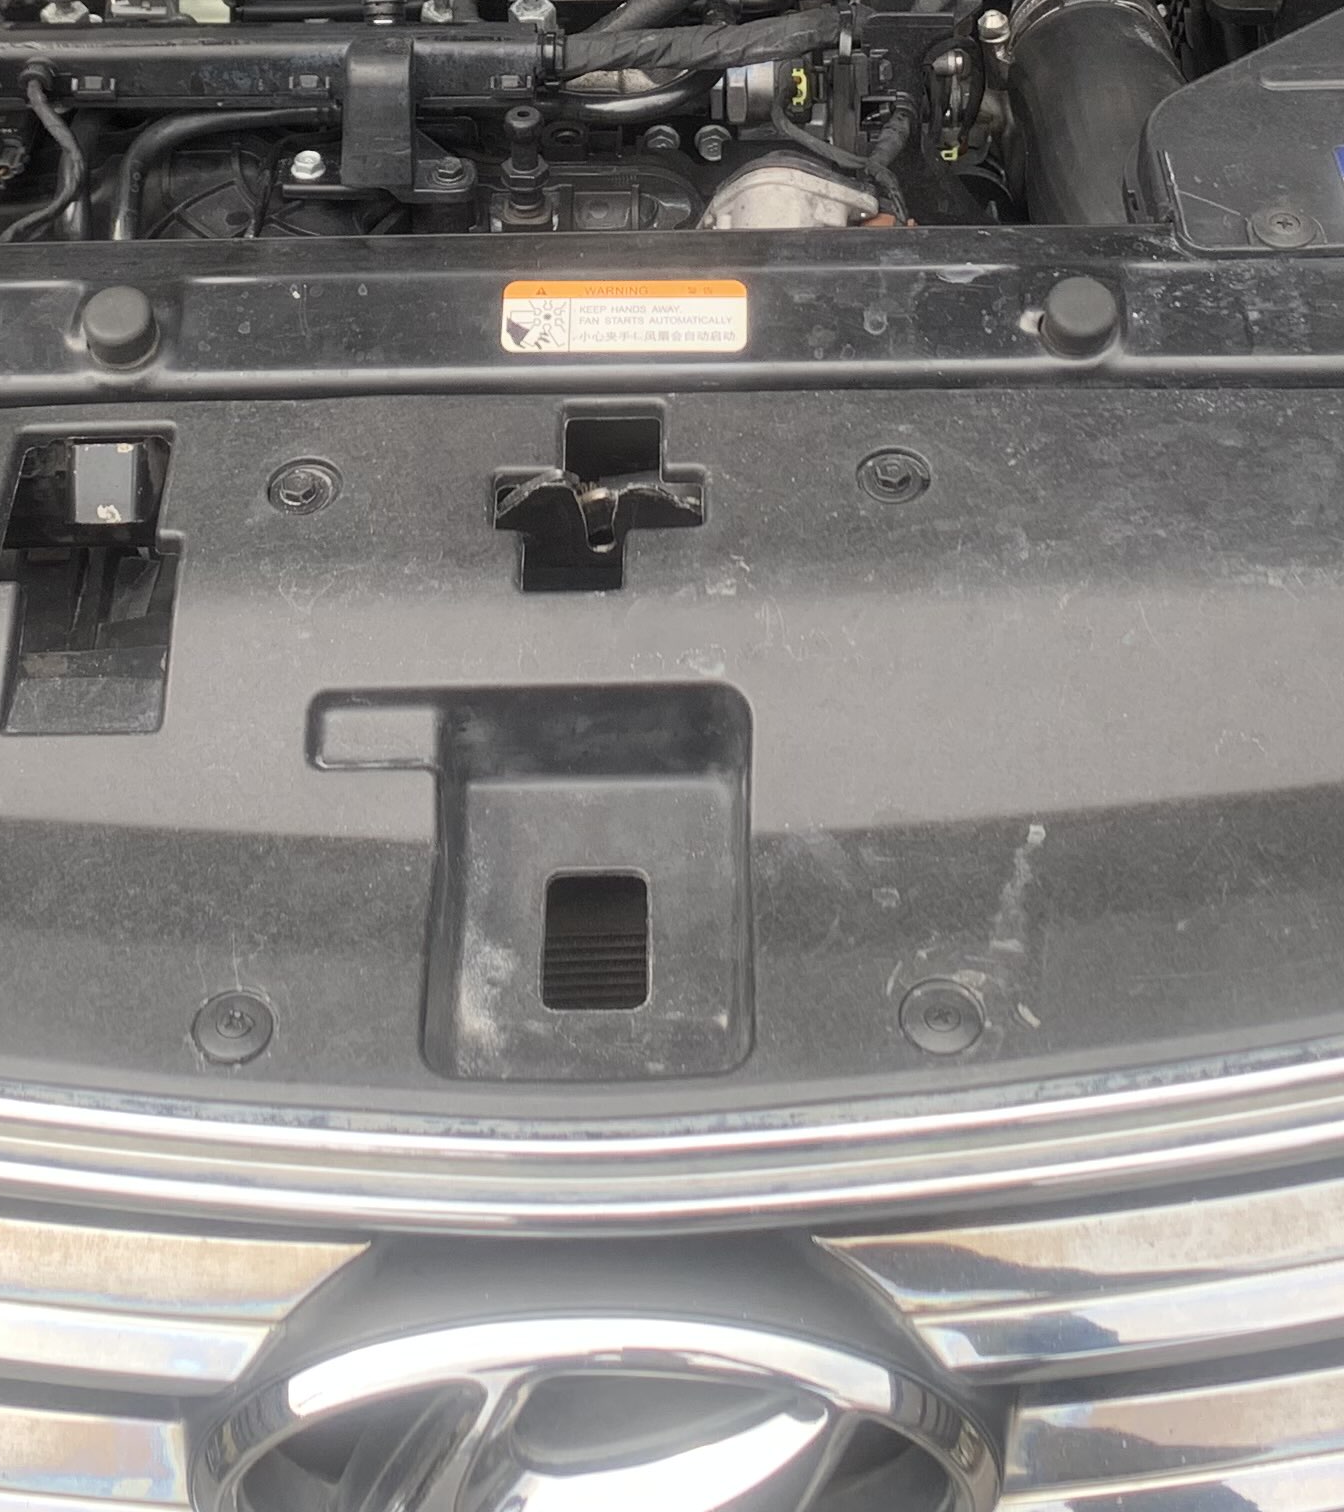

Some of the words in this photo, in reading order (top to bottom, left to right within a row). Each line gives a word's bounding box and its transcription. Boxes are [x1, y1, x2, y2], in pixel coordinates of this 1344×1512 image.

[584, 287, 649, 296] WARNING
[579, 305, 606, 314] KEEP
[611, 305, 647, 314] HANDS
[579, 317, 600, 325] FAN
[604, 316, 644, 325] STARTS
[649, 316, 732, 325] AUTOMATICALLY
